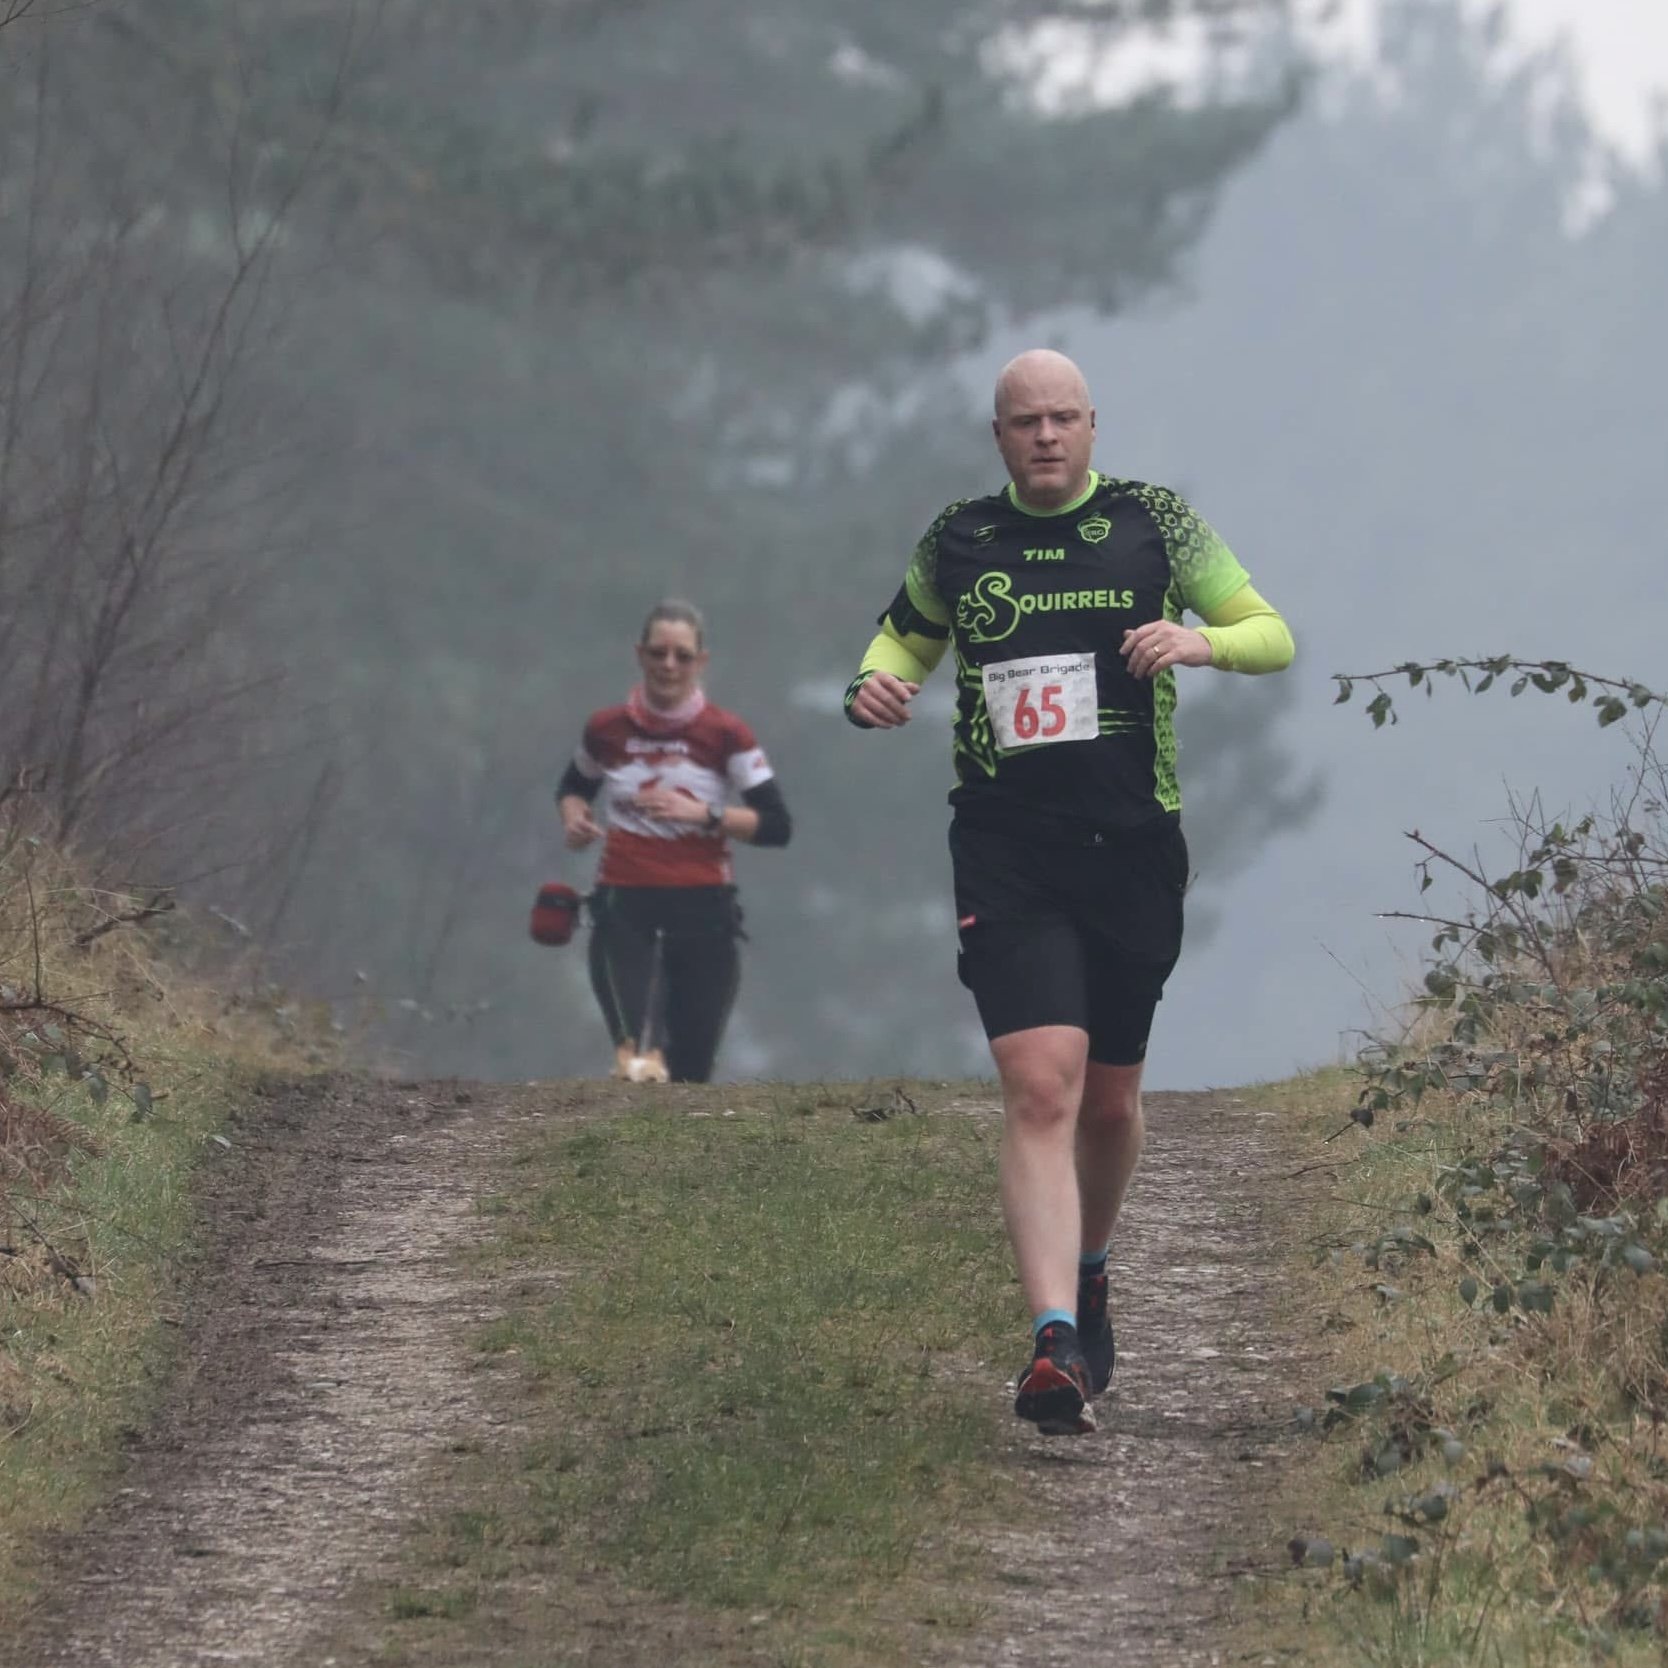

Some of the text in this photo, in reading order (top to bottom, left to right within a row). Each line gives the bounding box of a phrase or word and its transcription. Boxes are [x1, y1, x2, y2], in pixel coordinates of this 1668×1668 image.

[1023, 548, 1065, 561] TIM
[957, 571, 1134, 642] SQUIRRELS
[988, 663, 1090, 682] Big Bear Brigade
[1013, 685, 1066, 740] 65
